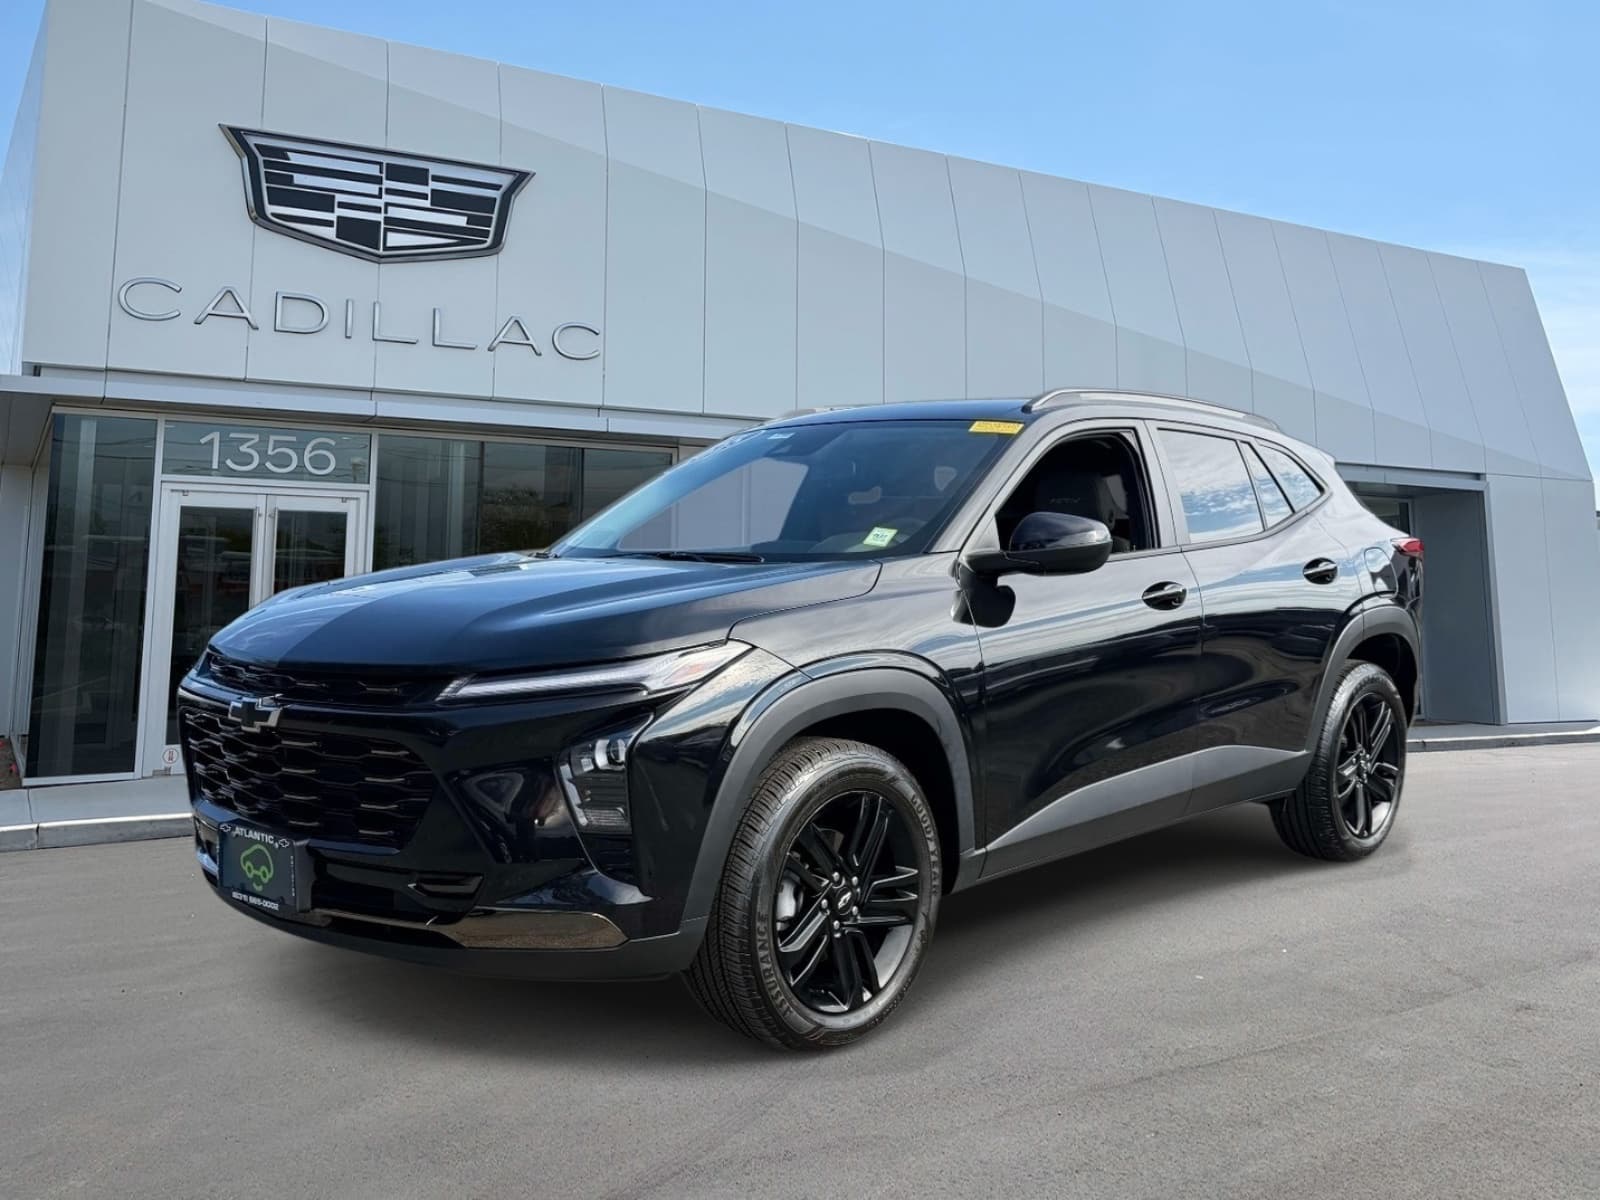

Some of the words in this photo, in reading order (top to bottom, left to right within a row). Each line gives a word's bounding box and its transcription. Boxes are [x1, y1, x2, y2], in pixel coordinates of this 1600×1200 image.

[118, 276, 601, 361] CADILLAC
[199, 431, 337, 475] 1356
[234, 827, 274, 844] ATLANTIC
[756, 911, 795, 1018] ASSURANCE
